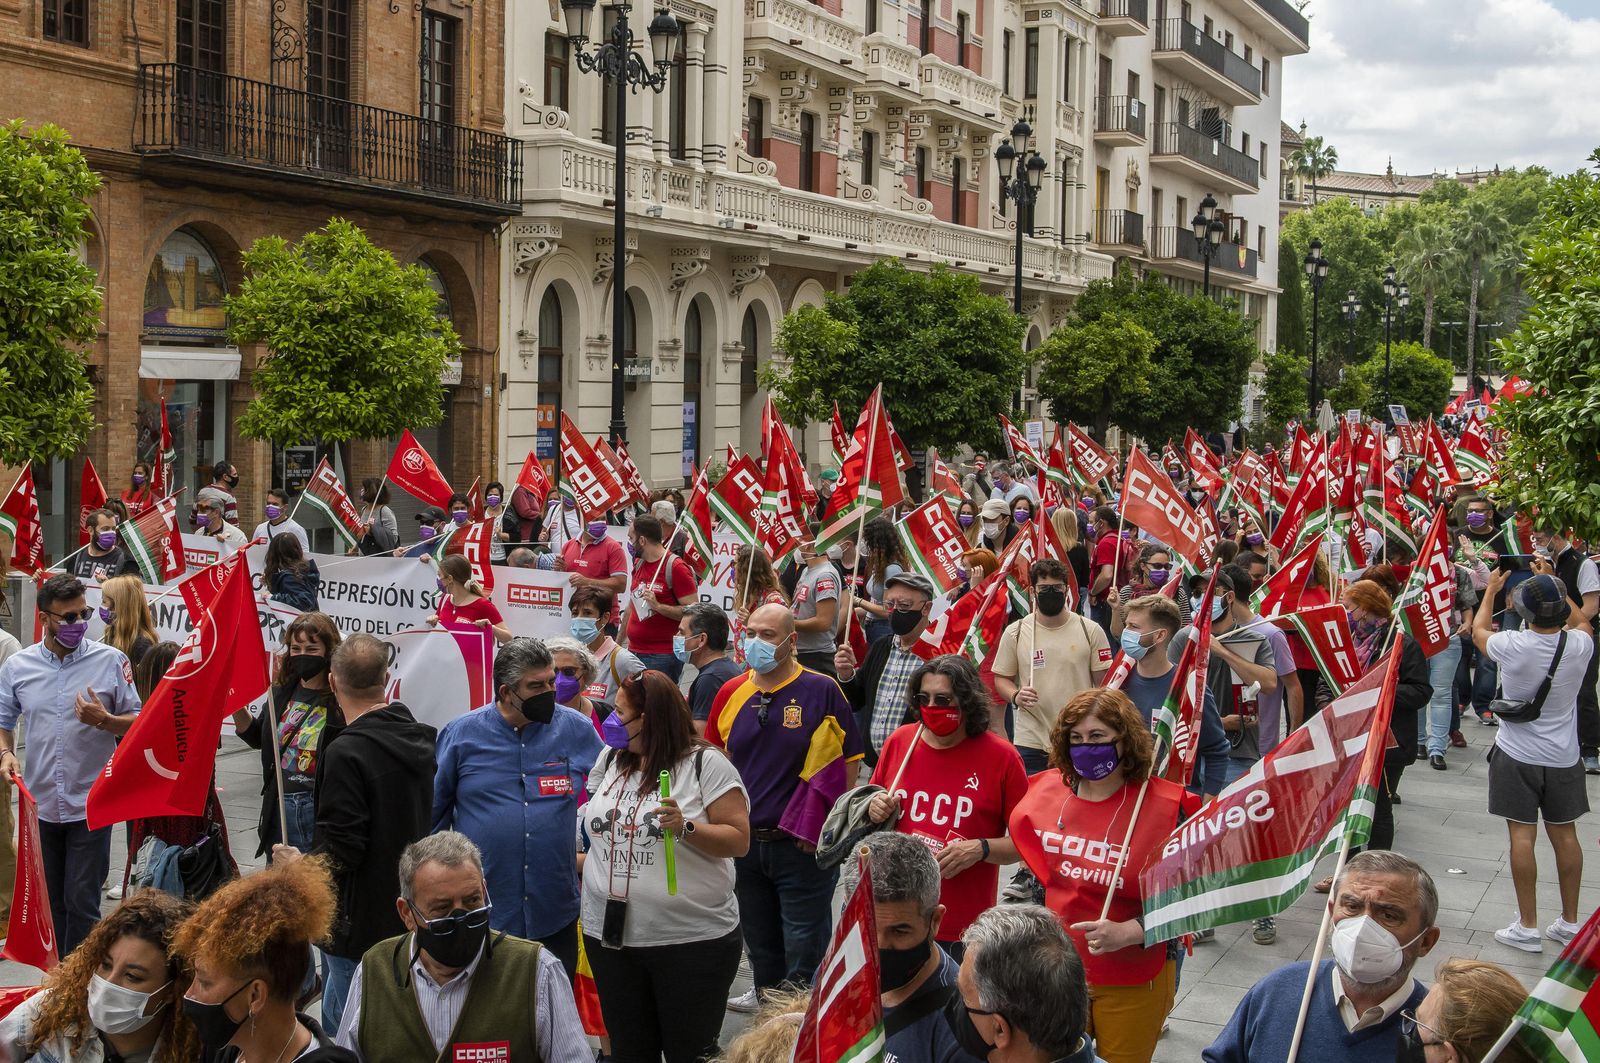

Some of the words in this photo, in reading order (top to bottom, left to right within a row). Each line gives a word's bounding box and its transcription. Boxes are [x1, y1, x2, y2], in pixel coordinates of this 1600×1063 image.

[1077, 455, 1098, 479] Sevilla
[340, 501, 364, 528] Sevilla
[1128, 469, 1201, 543] CCOO
[934, 546, 958, 581] Sevilla
[315, 580, 414, 609] REPRESIÓN
[510, 587, 550, 602] CCOO
[548, 610, 563, 618] sevilla
[1417, 591, 1440, 644] Sevilla
[366, 619, 393, 636] DEL
[540, 779, 567, 787] CCOO
[894, 788, 974, 829] CCCP
[602, 848, 654, 866] MINNIE
[1059, 860, 1124, 890] Sevilla
[456, 1047, 497, 1060] CCOO
